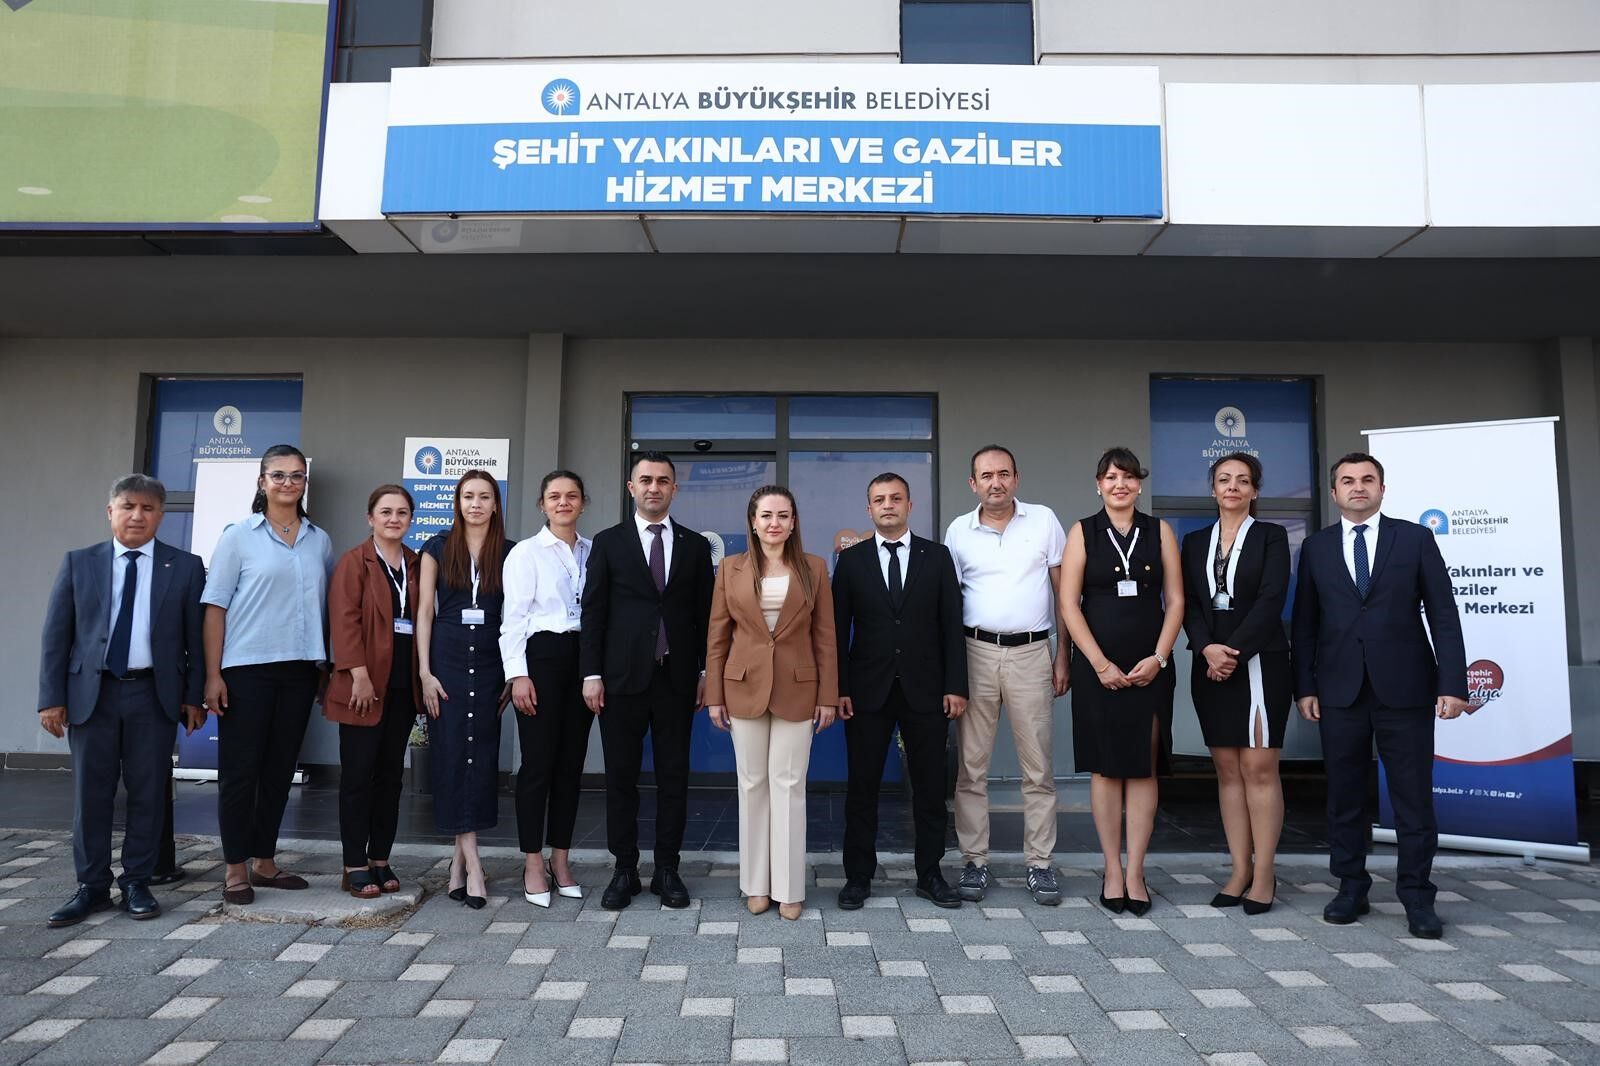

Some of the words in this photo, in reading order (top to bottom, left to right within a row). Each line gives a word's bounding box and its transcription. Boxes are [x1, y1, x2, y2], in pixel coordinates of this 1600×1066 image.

[586, 92, 690, 110] ANTALYA
[698, 86, 857, 114] BÜYÜKŞEHİR
[866, 87, 990, 111] BELEDİYESİ
[491, 131, 604, 171] ŞEHİT
[612, 136, 820, 164] YAKINLARI
[830, 137, 883, 164] VE
[893, 132, 1063, 167] GAZİLER
[606, 170, 752, 203] HİZMET
[761, 171, 934, 203] MERKEZİ
[208, 437, 244, 445] ANTALYA
[199, 445, 252, 456] BÜYÜKŞEHİR
[445, 457, 497, 467] BÜYÜKŞEHİR
[413, 483, 438, 492] ŞEHİT
[419, 501, 444, 510] HİZMET
[1451, 516, 1509, 526] BÜYÜKŞEHİR
[1452, 525, 1497, 535] BELEDİYESİ
[1522, 566, 1544, 577] ve
[1451, 583, 1498, 596] aziler
[1464, 601, 1535, 614] Merkezi
